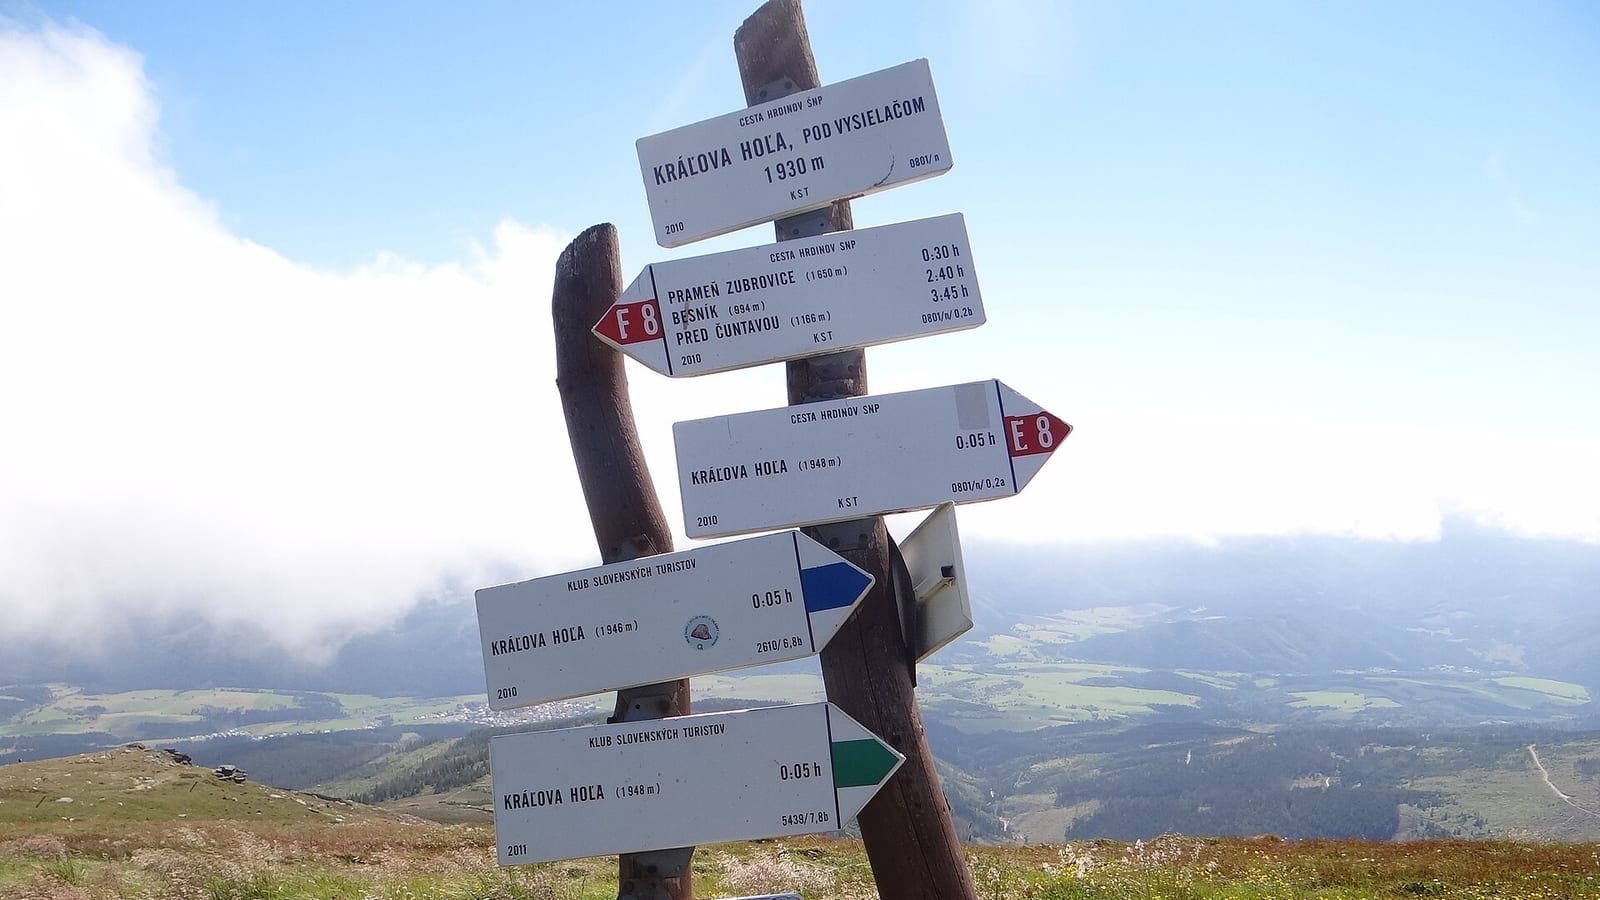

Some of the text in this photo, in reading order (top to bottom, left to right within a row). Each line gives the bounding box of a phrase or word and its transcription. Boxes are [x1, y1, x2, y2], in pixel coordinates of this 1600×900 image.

[740, 113, 764, 127] CESTA
[767, 101, 802, 119] HRDINOV
[654, 96, 925, 185] KRÁĽOVA HOĽA, POD VYSIELAČOM
[811, 156, 824, 171] m
[665, 222, 684, 234] 2010
[770, 240, 855, 262] CESTA HRDINOV SNP
[922, 244, 959, 261] 0:30 h
[926, 265, 964, 282] 2:40 h
[668, 281, 719, 304] PRAMEŇ
[726, 270, 796, 294] ZUBROVICE
[931, 284, 968, 302] 3:45 h
[642, 304, 658, 335] 8
[672, 303, 718, 326] BESNÍK
[676, 328, 708, 346] PRED
[716, 316, 779, 339] ČUNTAVOU
[681, 354, 701, 365] 2010
[791, 404, 879, 424] CESTA HRDINOV SNP
[956, 432, 995, 449] 0:05 h
[1011, 416, 1053, 451] E 8
[692, 465, 748, 485] KRÁĽOVA
[755, 460, 787, 476] HOĽA
[697, 515, 717, 527] 2010
[568, 559, 695, 591] KLUB SLOVENSKÝCH TURISTOV
[752, 589, 792, 608] 0:05 h
[492, 633, 546, 656] KRÁĽOVA
[553, 626, 585, 644] HOĽA
[498, 687, 517, 699] 2010
[589, 724, 724, 748] KLUB SLOVENSKÝCH TURISTOV
[781, 762, 821, 780] 0:05 h
[504, 789, 562, 810] KRÁĽOVA
[570, 785, 604, 802] HOĽA
[508, 845, 526, 856] 2011
